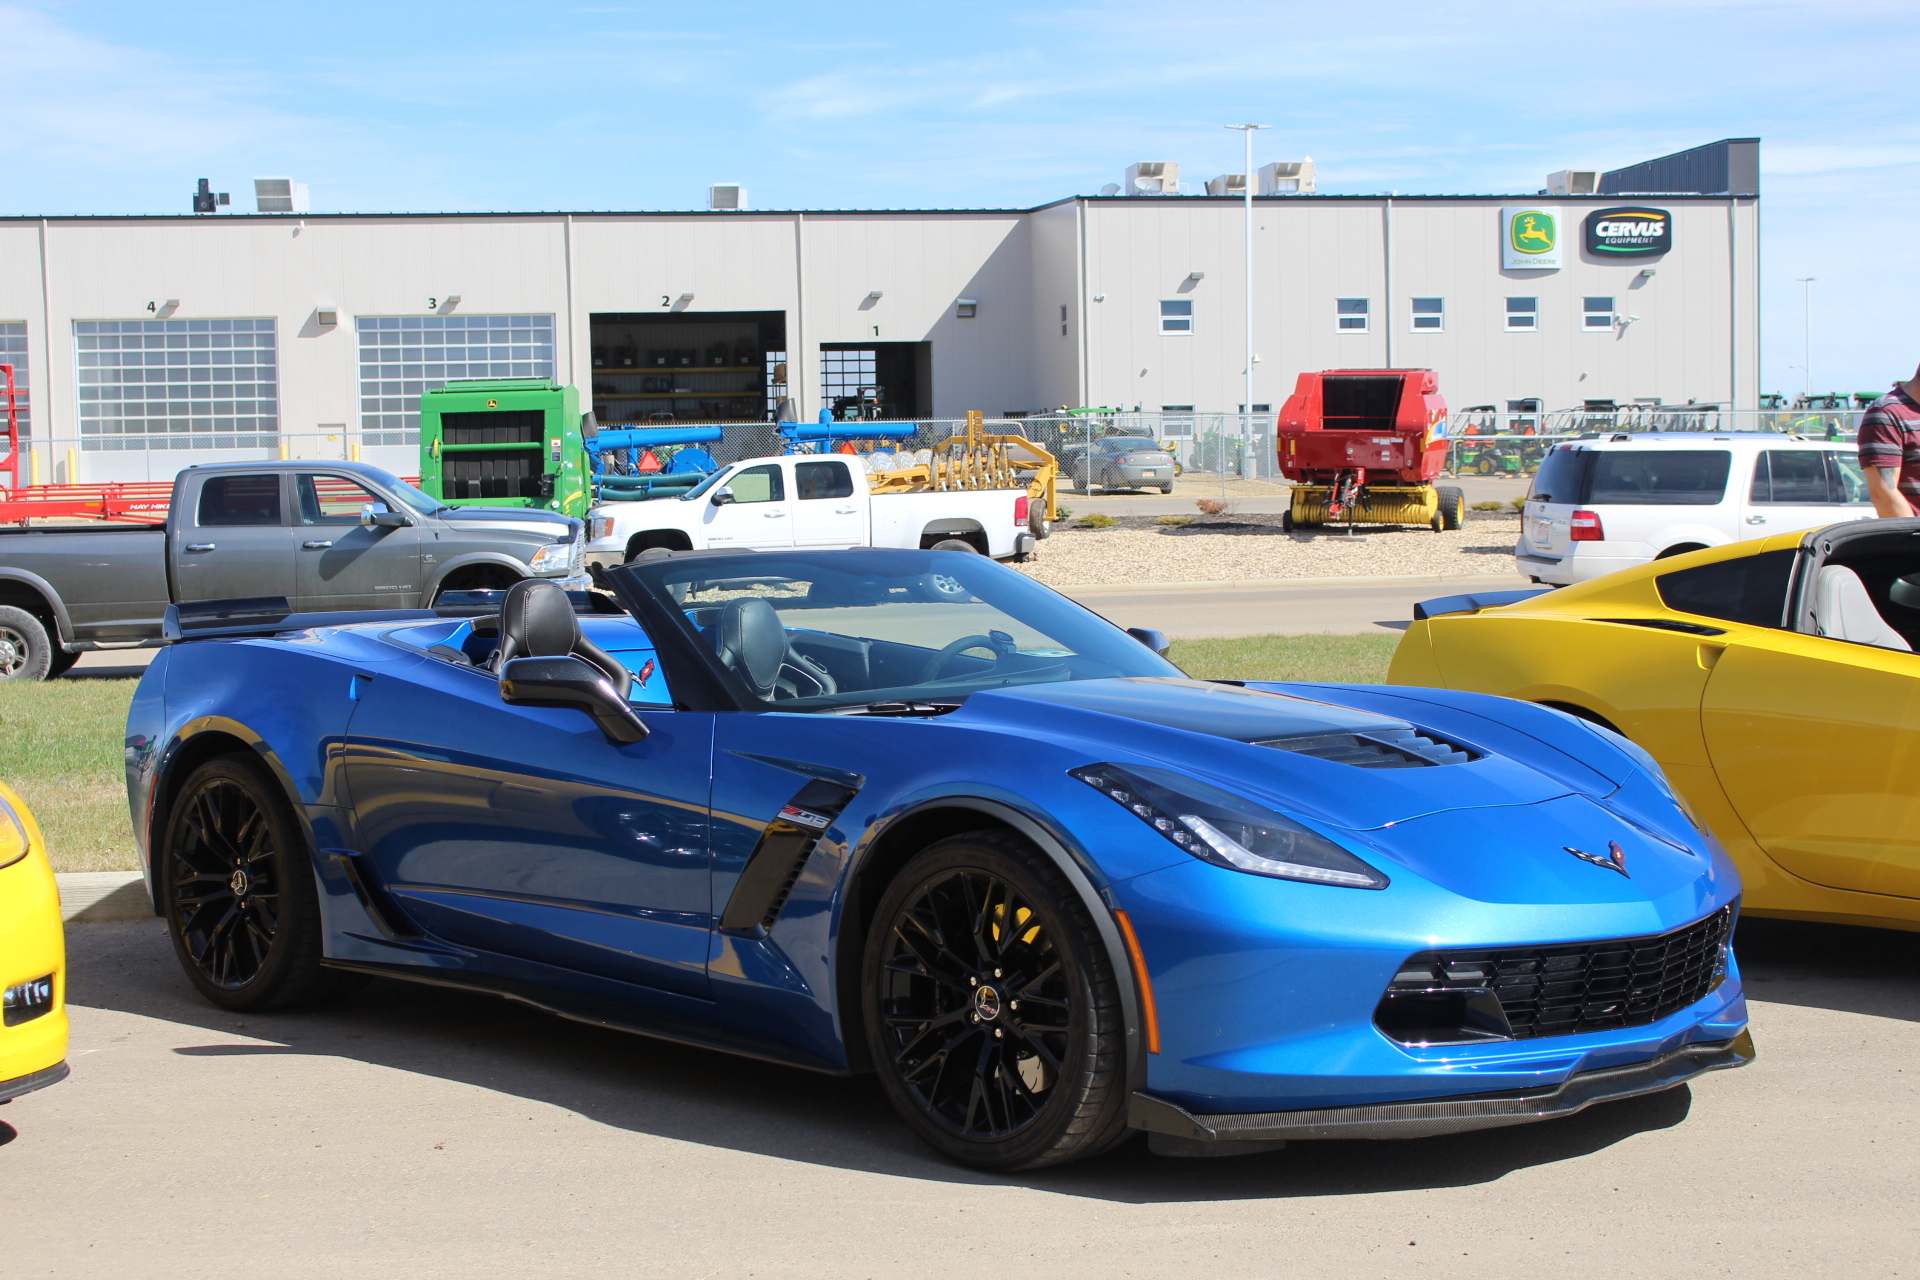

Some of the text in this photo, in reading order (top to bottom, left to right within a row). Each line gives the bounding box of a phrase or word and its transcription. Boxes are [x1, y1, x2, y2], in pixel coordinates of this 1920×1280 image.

[1595, 221, 1665, 237] CERVUS
[1510, 257, 1557, 266] JOHN DEERE
[146, 301, 156, 313] 4
[428, 297, 437, 310] 3
[661, 295, 671, 307] 2
[872, 325, 879, 337] 1
